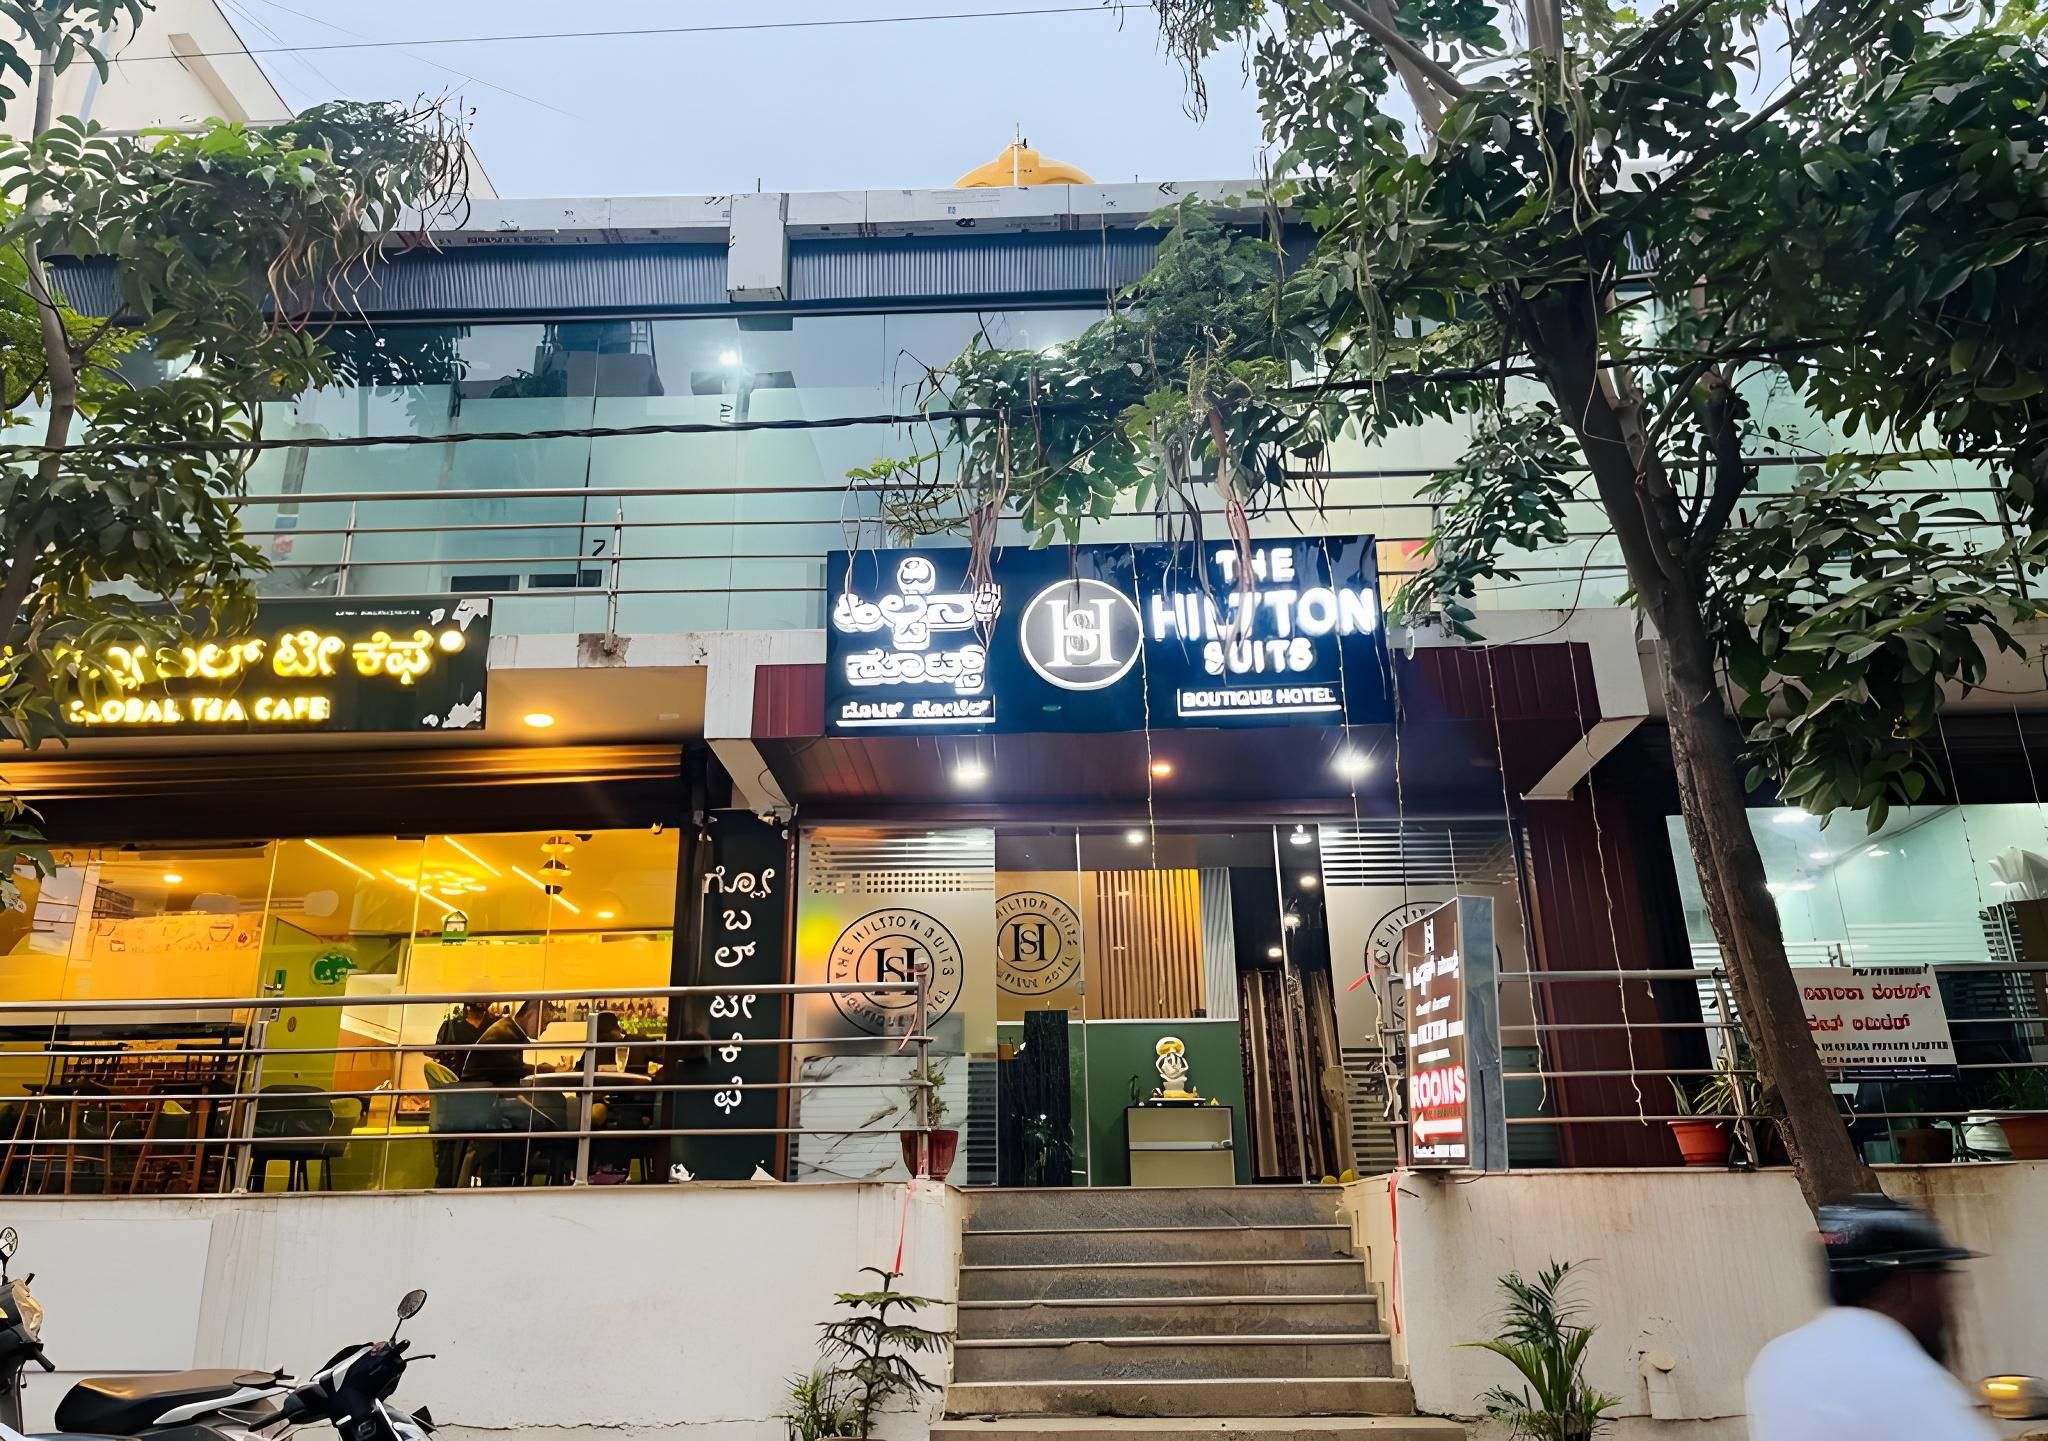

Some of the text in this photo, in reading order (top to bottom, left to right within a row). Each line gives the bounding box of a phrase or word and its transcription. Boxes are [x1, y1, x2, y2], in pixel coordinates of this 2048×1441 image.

[1276, 687, 1337, 704] HOTEL
[255, 697, 330, 720] CAFE
[1410, 1065, 1466, 1109] ROOMS
